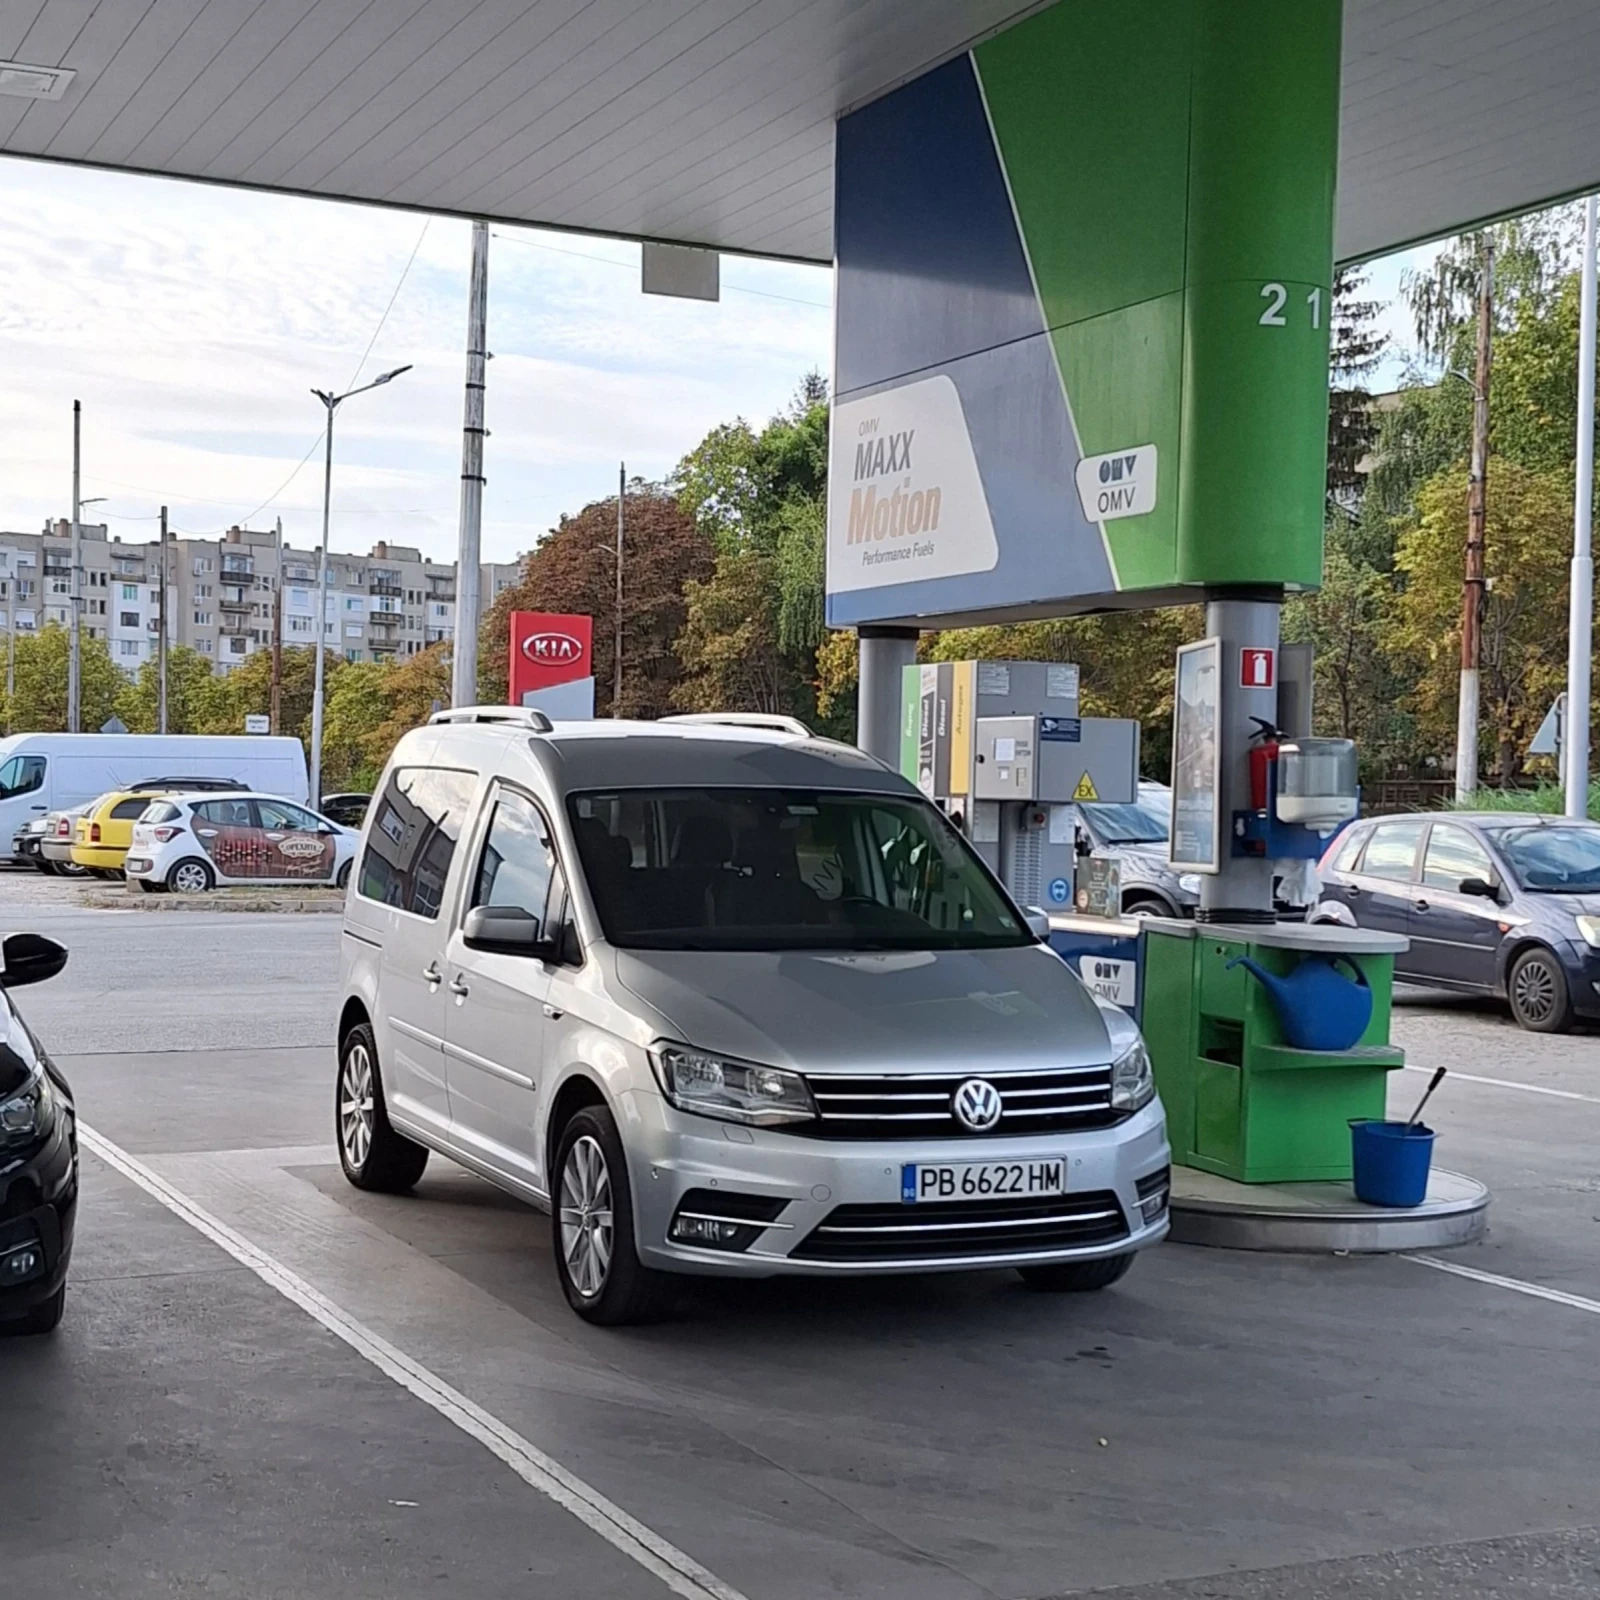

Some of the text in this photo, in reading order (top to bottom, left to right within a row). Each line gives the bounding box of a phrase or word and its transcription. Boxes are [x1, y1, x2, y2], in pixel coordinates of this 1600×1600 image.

[1259, 283, 1320, 330] 2 1
[859, 417, 880, 436] OMV
[854, 429, 915, 481] MAXX
[847, 476, 942, 546] Motion
[1098, 486, 1136, 513] OMV
[862, 540, 935, 566] Performance Fuels
[534, 639, 572, 657] KIA
[921, 699, 930, 738] Diesel
[938, 699, 947, 737] Diesel
[1078, 785, 1093, 797] EX
[921, 1168, 955, 1197] PB
[961, 1165, 1023, 1195] 6622
[1029, 1163, 1061, 1192] HM
